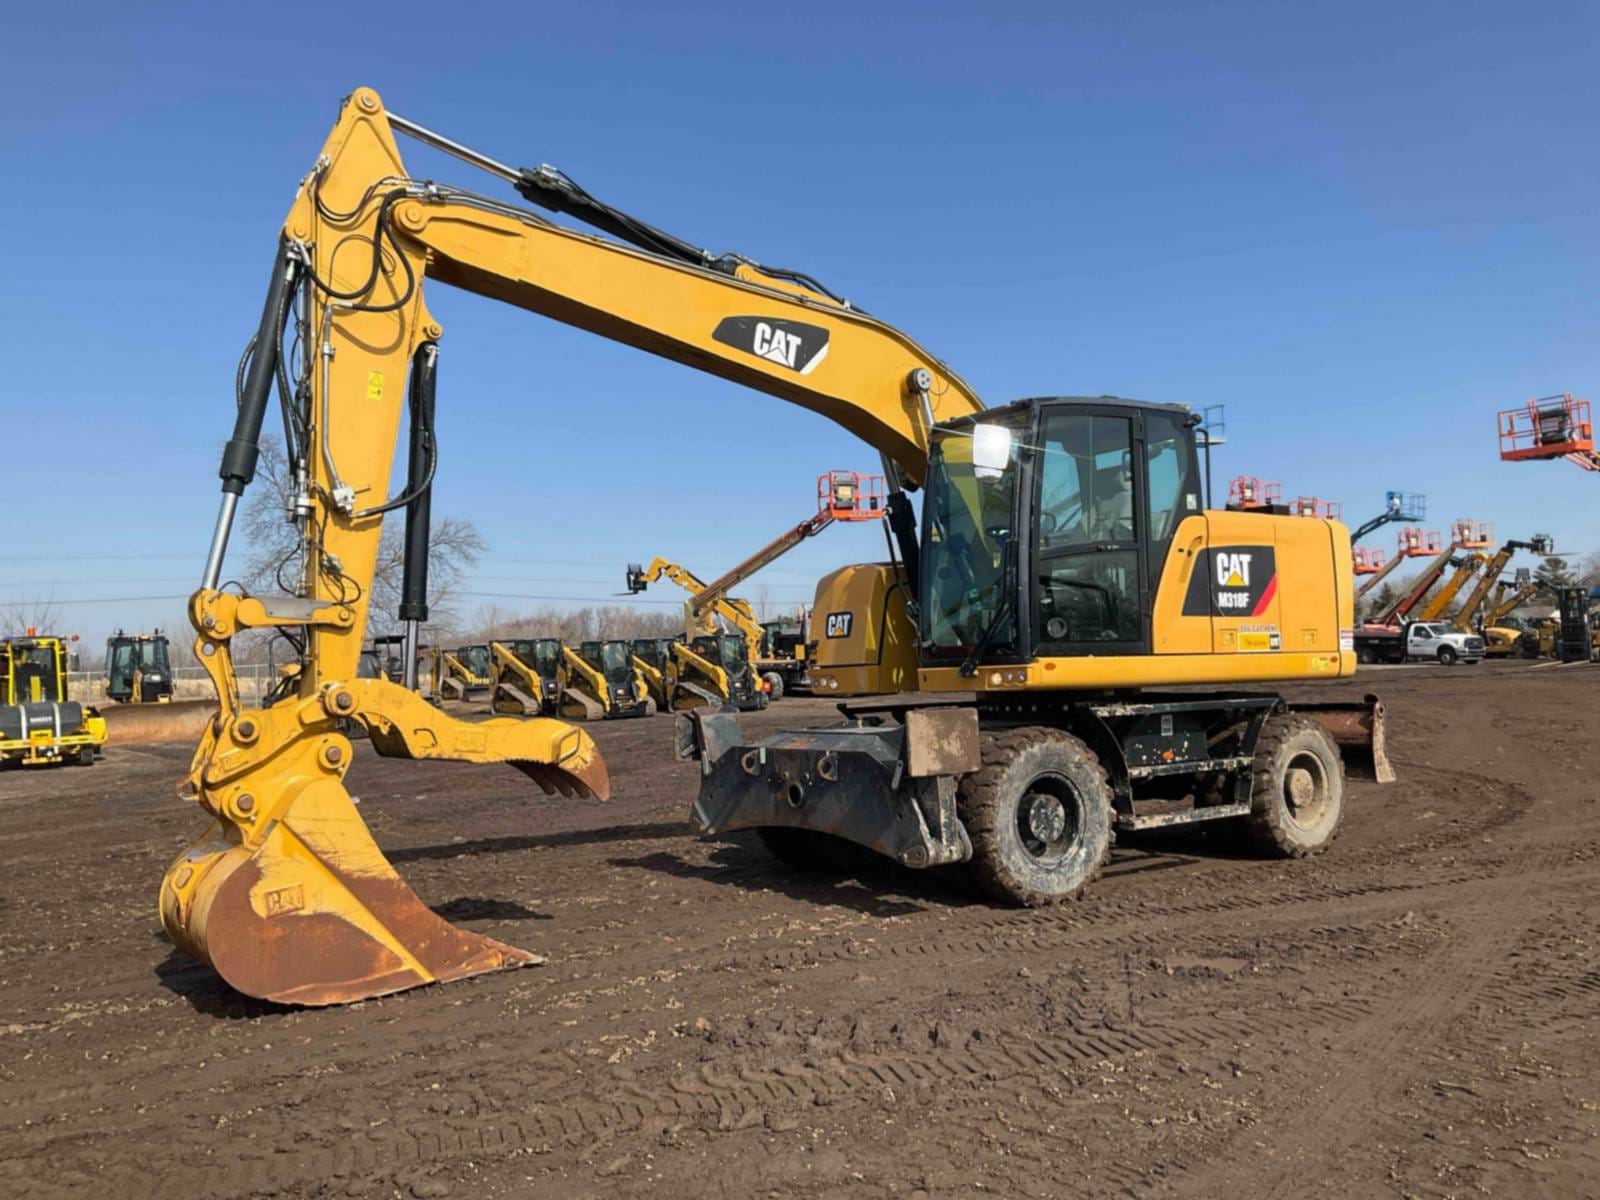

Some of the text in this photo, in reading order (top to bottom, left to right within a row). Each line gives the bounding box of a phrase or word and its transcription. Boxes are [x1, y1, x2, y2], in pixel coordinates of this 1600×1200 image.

[753, 322, 802, 368] CAT
[1216, 552, 1252, 587] CAT
[1218, 592, 1250, 608] M318F
[827, 614, 851, 637] CAT
